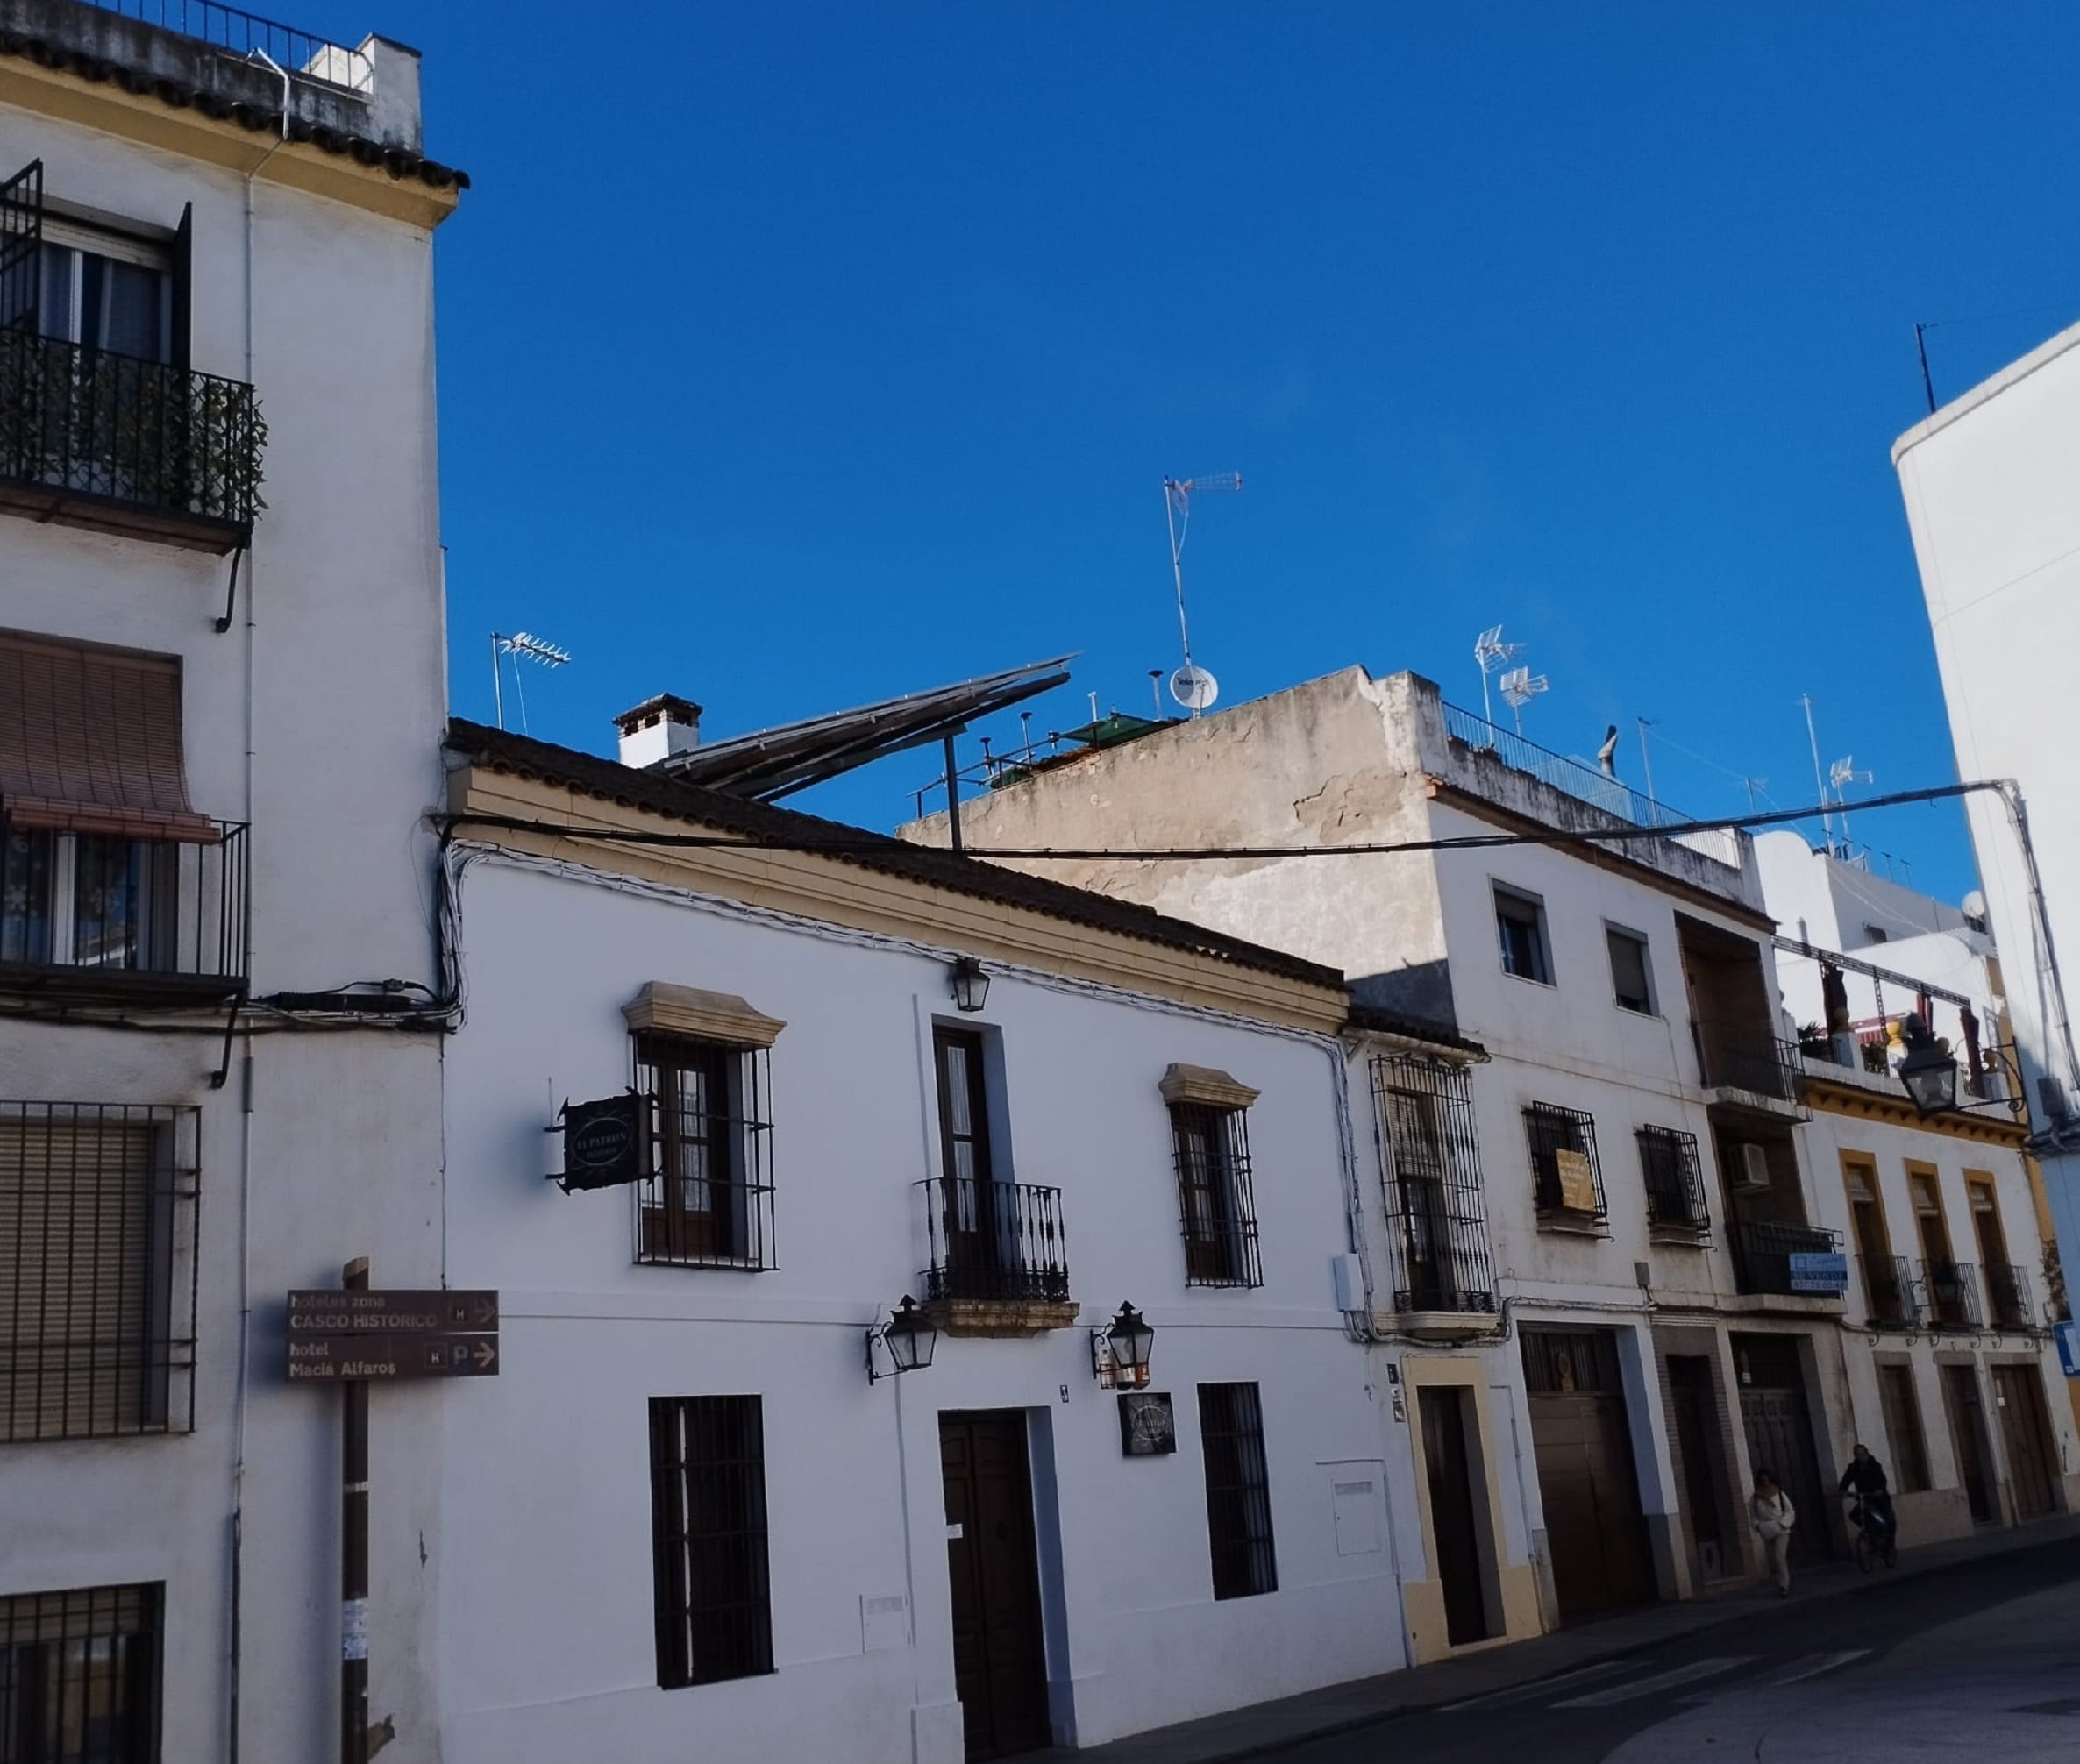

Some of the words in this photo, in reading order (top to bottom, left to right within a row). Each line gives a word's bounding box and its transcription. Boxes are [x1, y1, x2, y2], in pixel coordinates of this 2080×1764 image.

[291, 1296, 346, 1308] hoteles
[352, 1298, 386, 1308] zona
[291, 1315, 349, 1329] CASCO
[353, 1312, 437, 1327] HISTÓRICO
[290, 1343, 329, 1356] hotel
[453, 1346, 468, 1364] P
[341, 1361, 396, 1375] Alfaros
